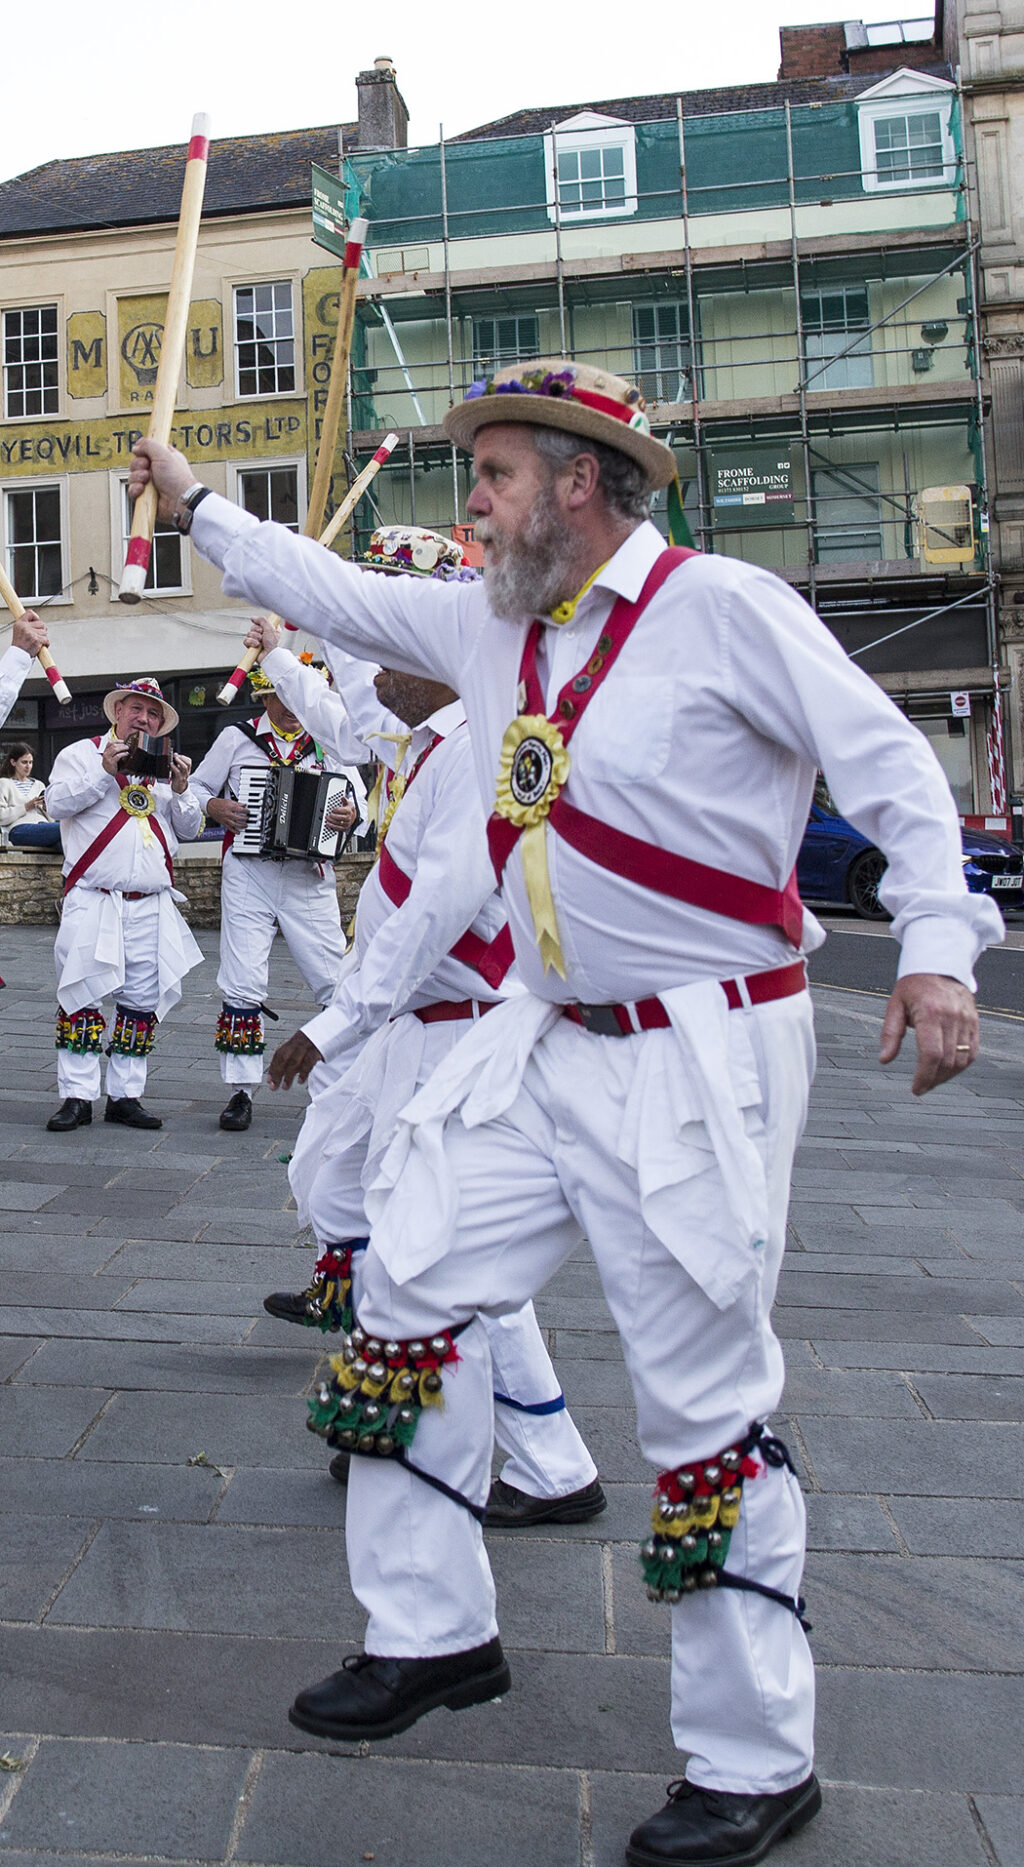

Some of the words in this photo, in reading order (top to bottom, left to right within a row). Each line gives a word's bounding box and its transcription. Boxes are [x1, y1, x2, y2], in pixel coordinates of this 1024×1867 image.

[192, 327, 219, 358] U
[71, 337, 103, 371] M
[130, 390, 154, 402] RA
[1, 434, 101, 464] YEOVIL
[112, 420, 251, 454] TRTORS
[265, 415, 301, 441] LTD
[717, 467, 754, 479] FROME
[717, 474, 789, 488] SCAFFOLDING
